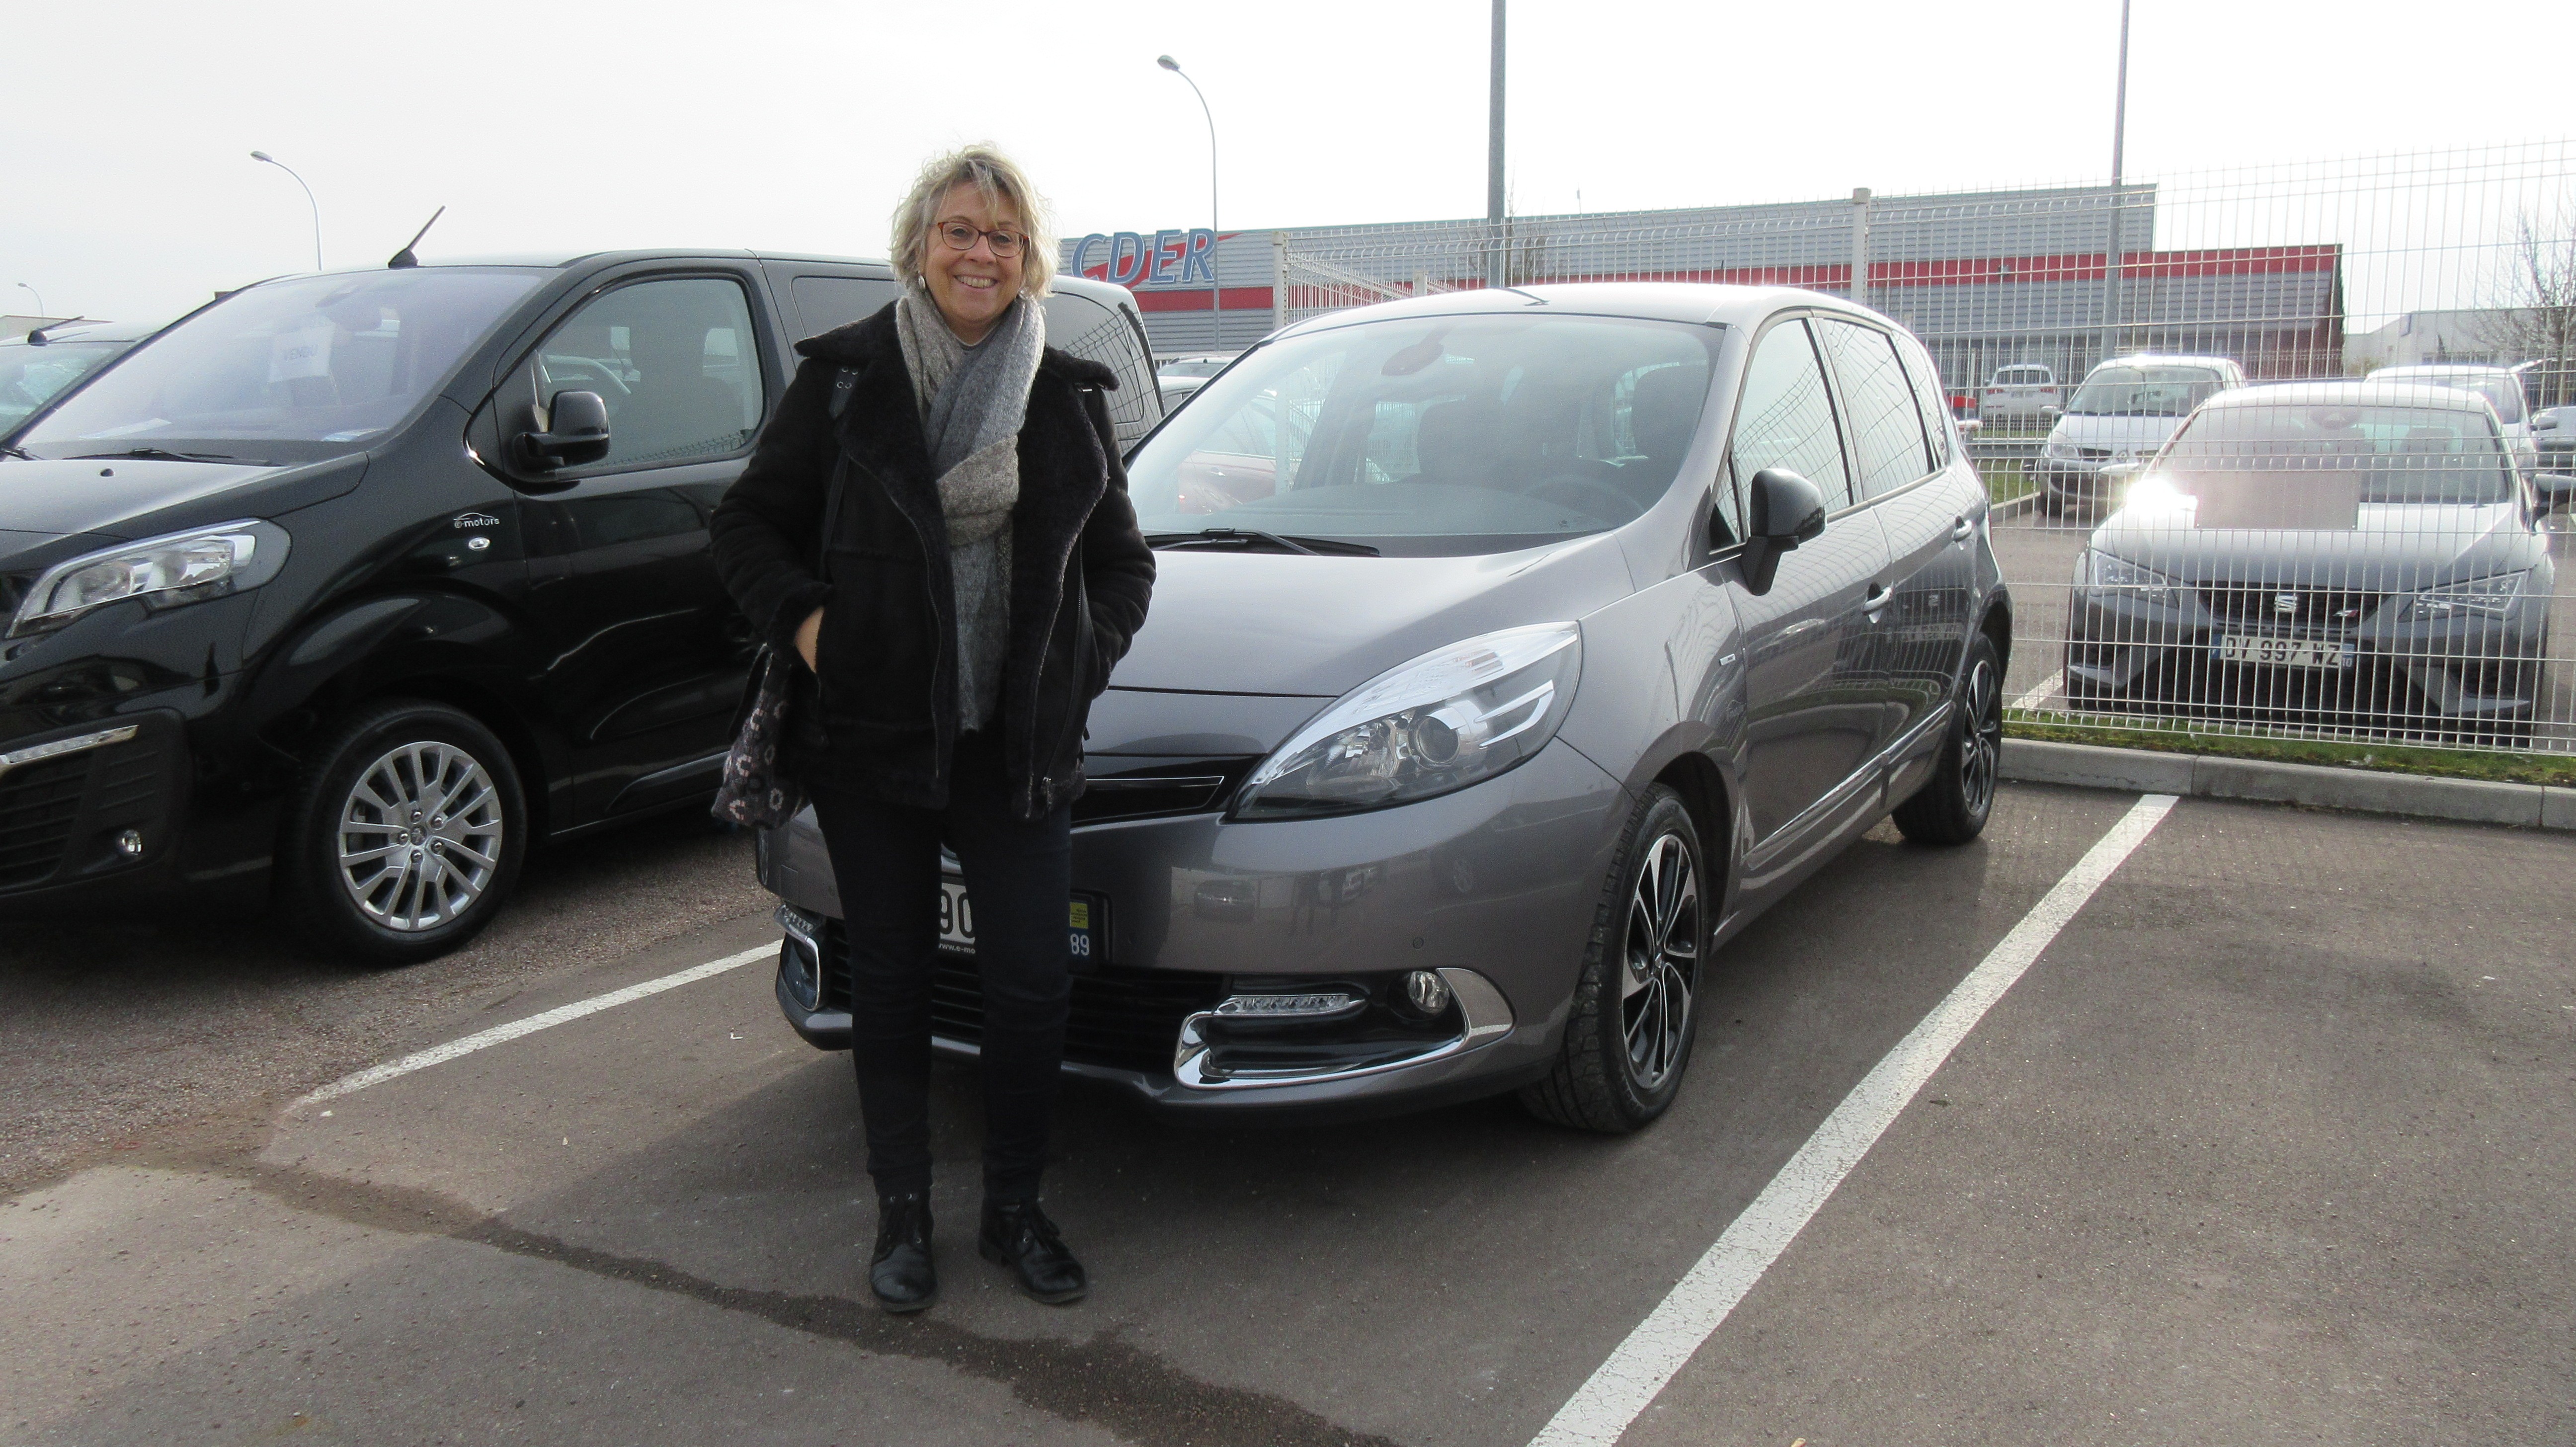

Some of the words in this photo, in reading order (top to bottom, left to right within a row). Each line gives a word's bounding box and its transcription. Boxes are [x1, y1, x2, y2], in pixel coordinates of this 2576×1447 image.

[1071, 228, 1215, 284] CDER
[454, 518, 500, 528] e-motors
[1070, 933, 1090, 956] 89
